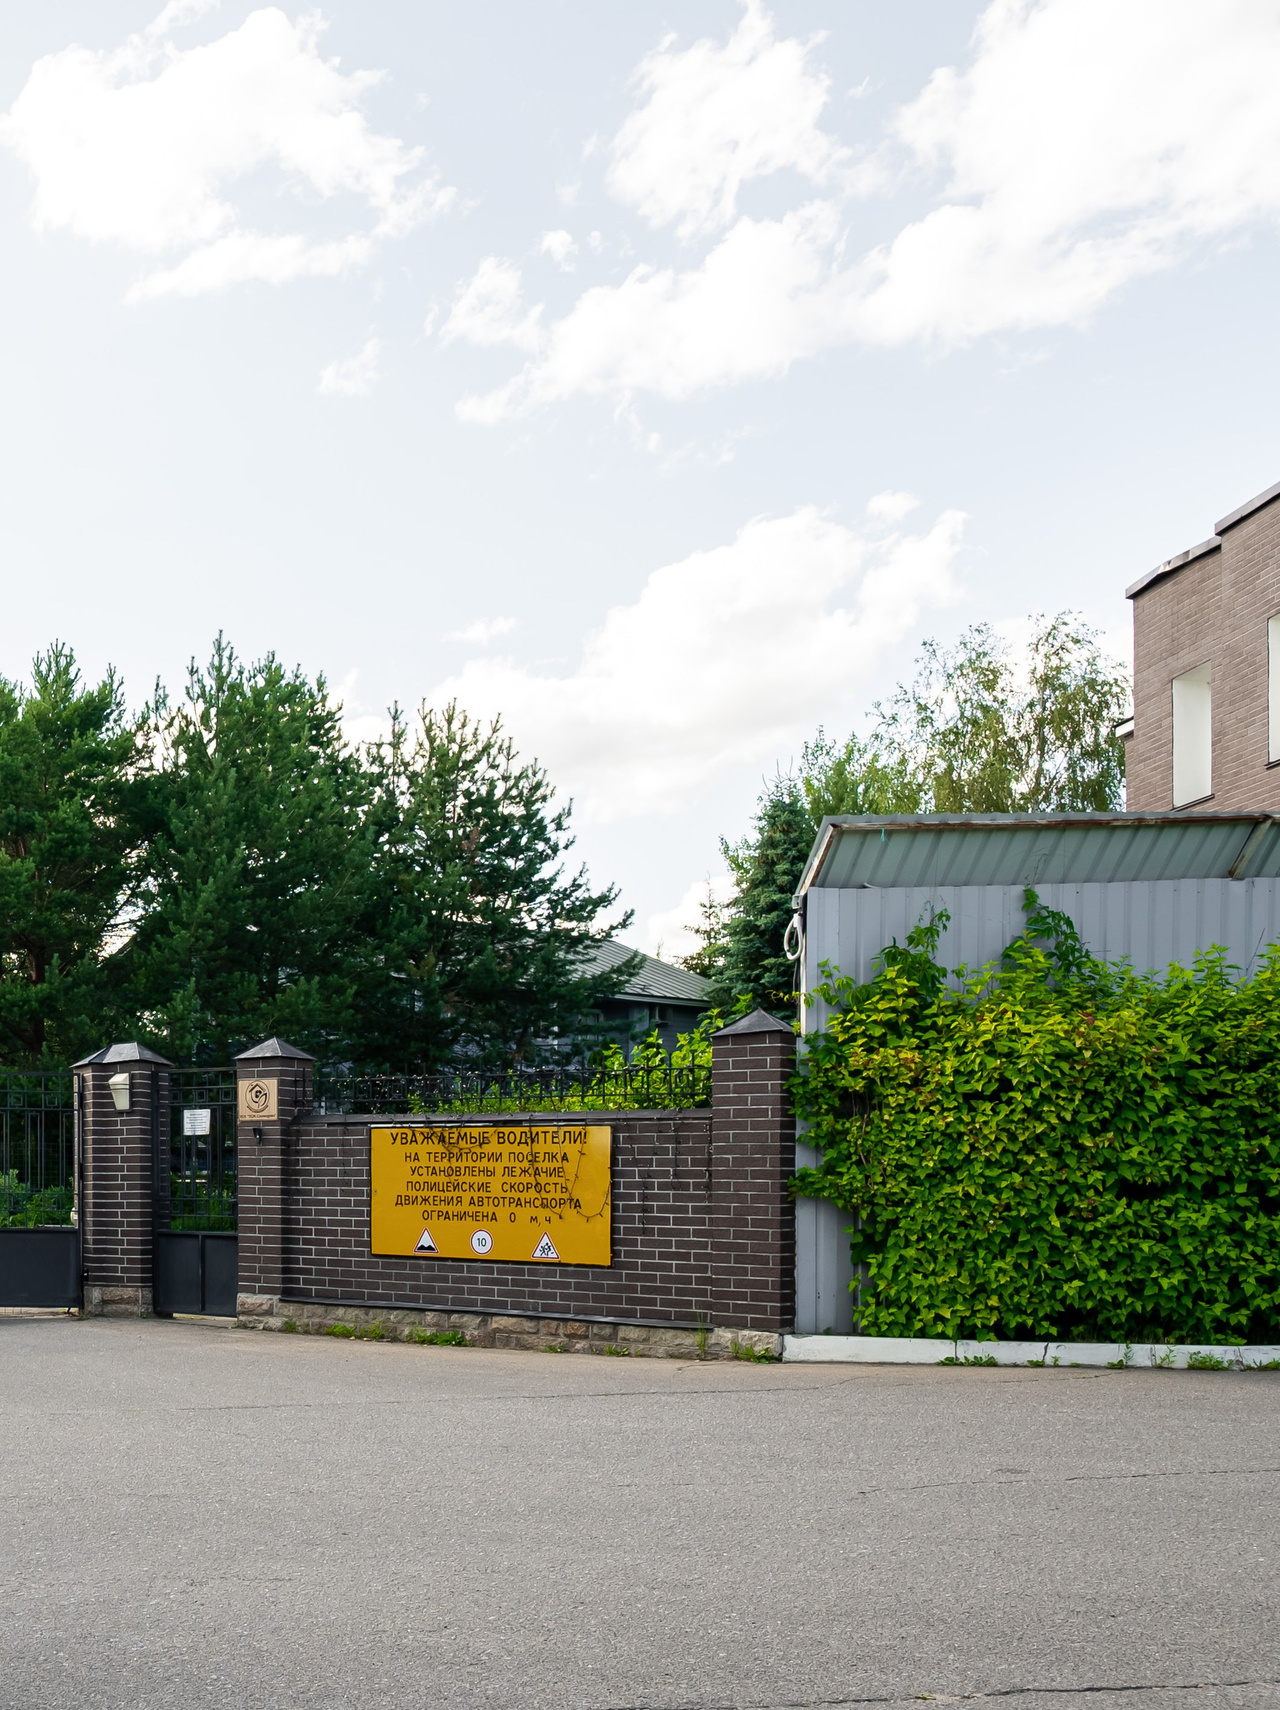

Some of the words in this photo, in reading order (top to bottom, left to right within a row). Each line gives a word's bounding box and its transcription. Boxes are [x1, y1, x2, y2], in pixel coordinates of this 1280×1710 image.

[390, 1131, 490, 1145] УВАЖАЕМЫЕ
[497, 1131, 587, 1146] ВОДИТЕЛИ!
[404, 1152, 420, 1162] НА
[426, 1152, 503, 1163] ТЕРРИТОРИИ
[508, 1152, 569, 1163] ПОСЕЛКА
[410, 1166, 496, 1177] УСТАНОВЛЕНЫ
[502, 1166, 564, 1178] ЛЕЖАЧИЕ
[406, 1179, 492, 1193] ПОЛИЦЕЙСКИЕ
[501, 1181, 568, 1193] СКОРОСТЬ
[395, 1195, 463, 1207] ДВИЖЕНИЯ
[468, 1196, 582, 1209] АВТОТРАНСПОРТА
[422, 1210, 498, 1222] ОГРАНИЧЕНА
[477, 1237, 487, 1247] 10
